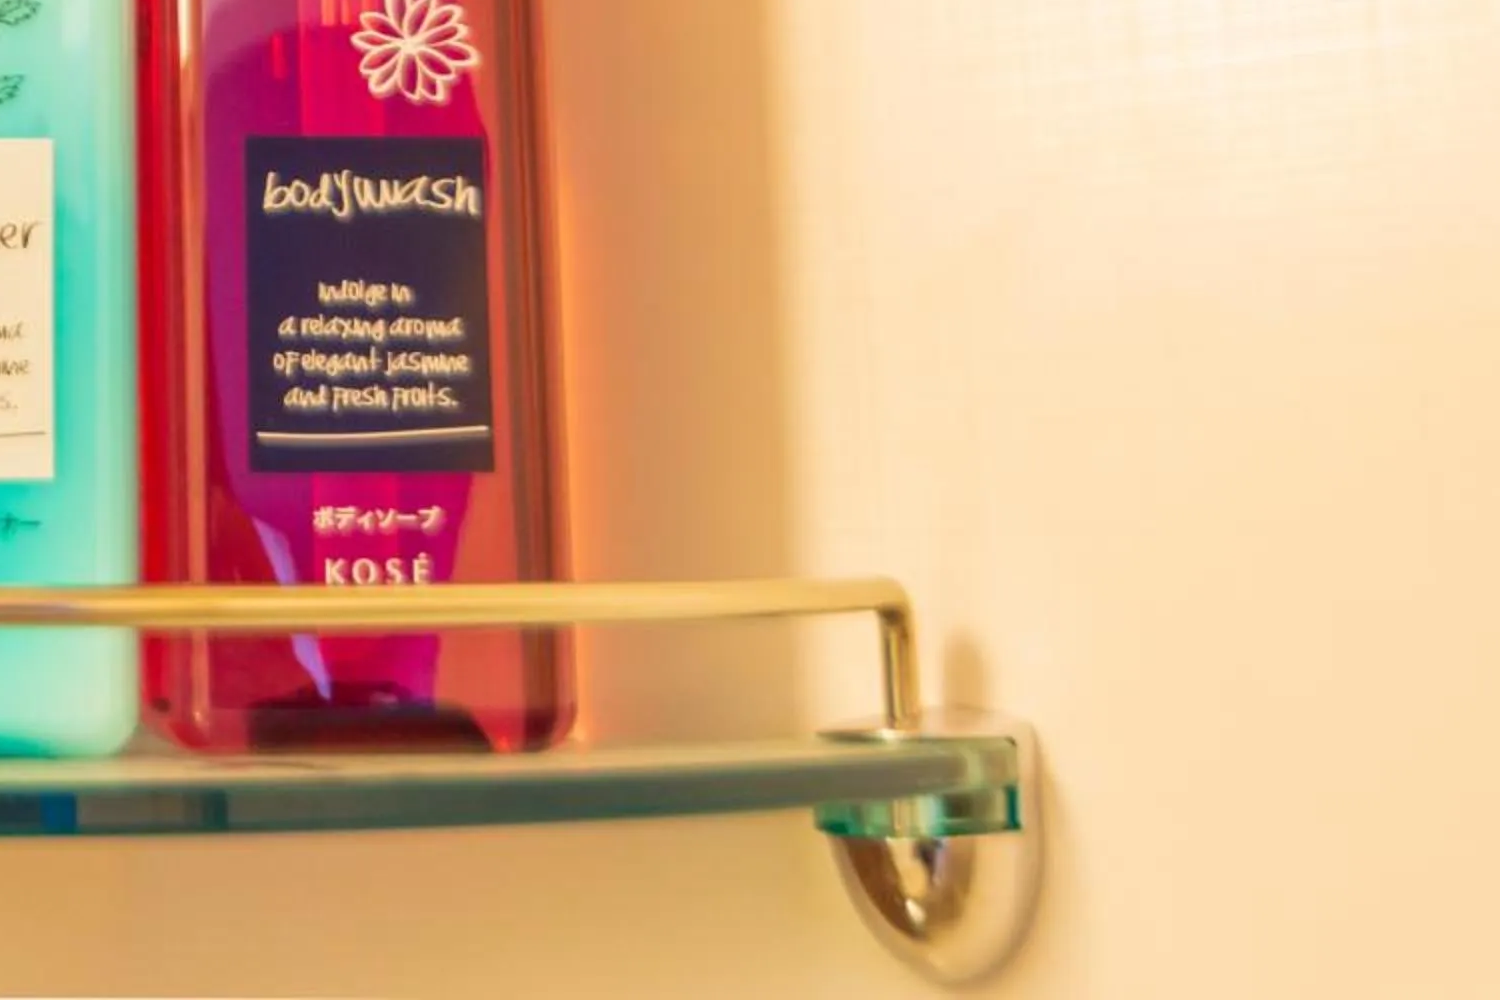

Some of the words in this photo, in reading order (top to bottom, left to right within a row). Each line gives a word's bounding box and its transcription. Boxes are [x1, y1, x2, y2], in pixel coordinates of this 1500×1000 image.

[391, 282, 412, 303] in
[277, 315, 296, 336] a
[300, 313, 385, 341] relaxing
[389, 316, 463, 339] aroma
[301, 346, 382, 376] elegant
[384, 351, 470, 376] jasmine
[283, 384, 327, 407] and
[312, 504, 443, 529] ボディソープ
[324, 551, 431, 585] KOSÉ
